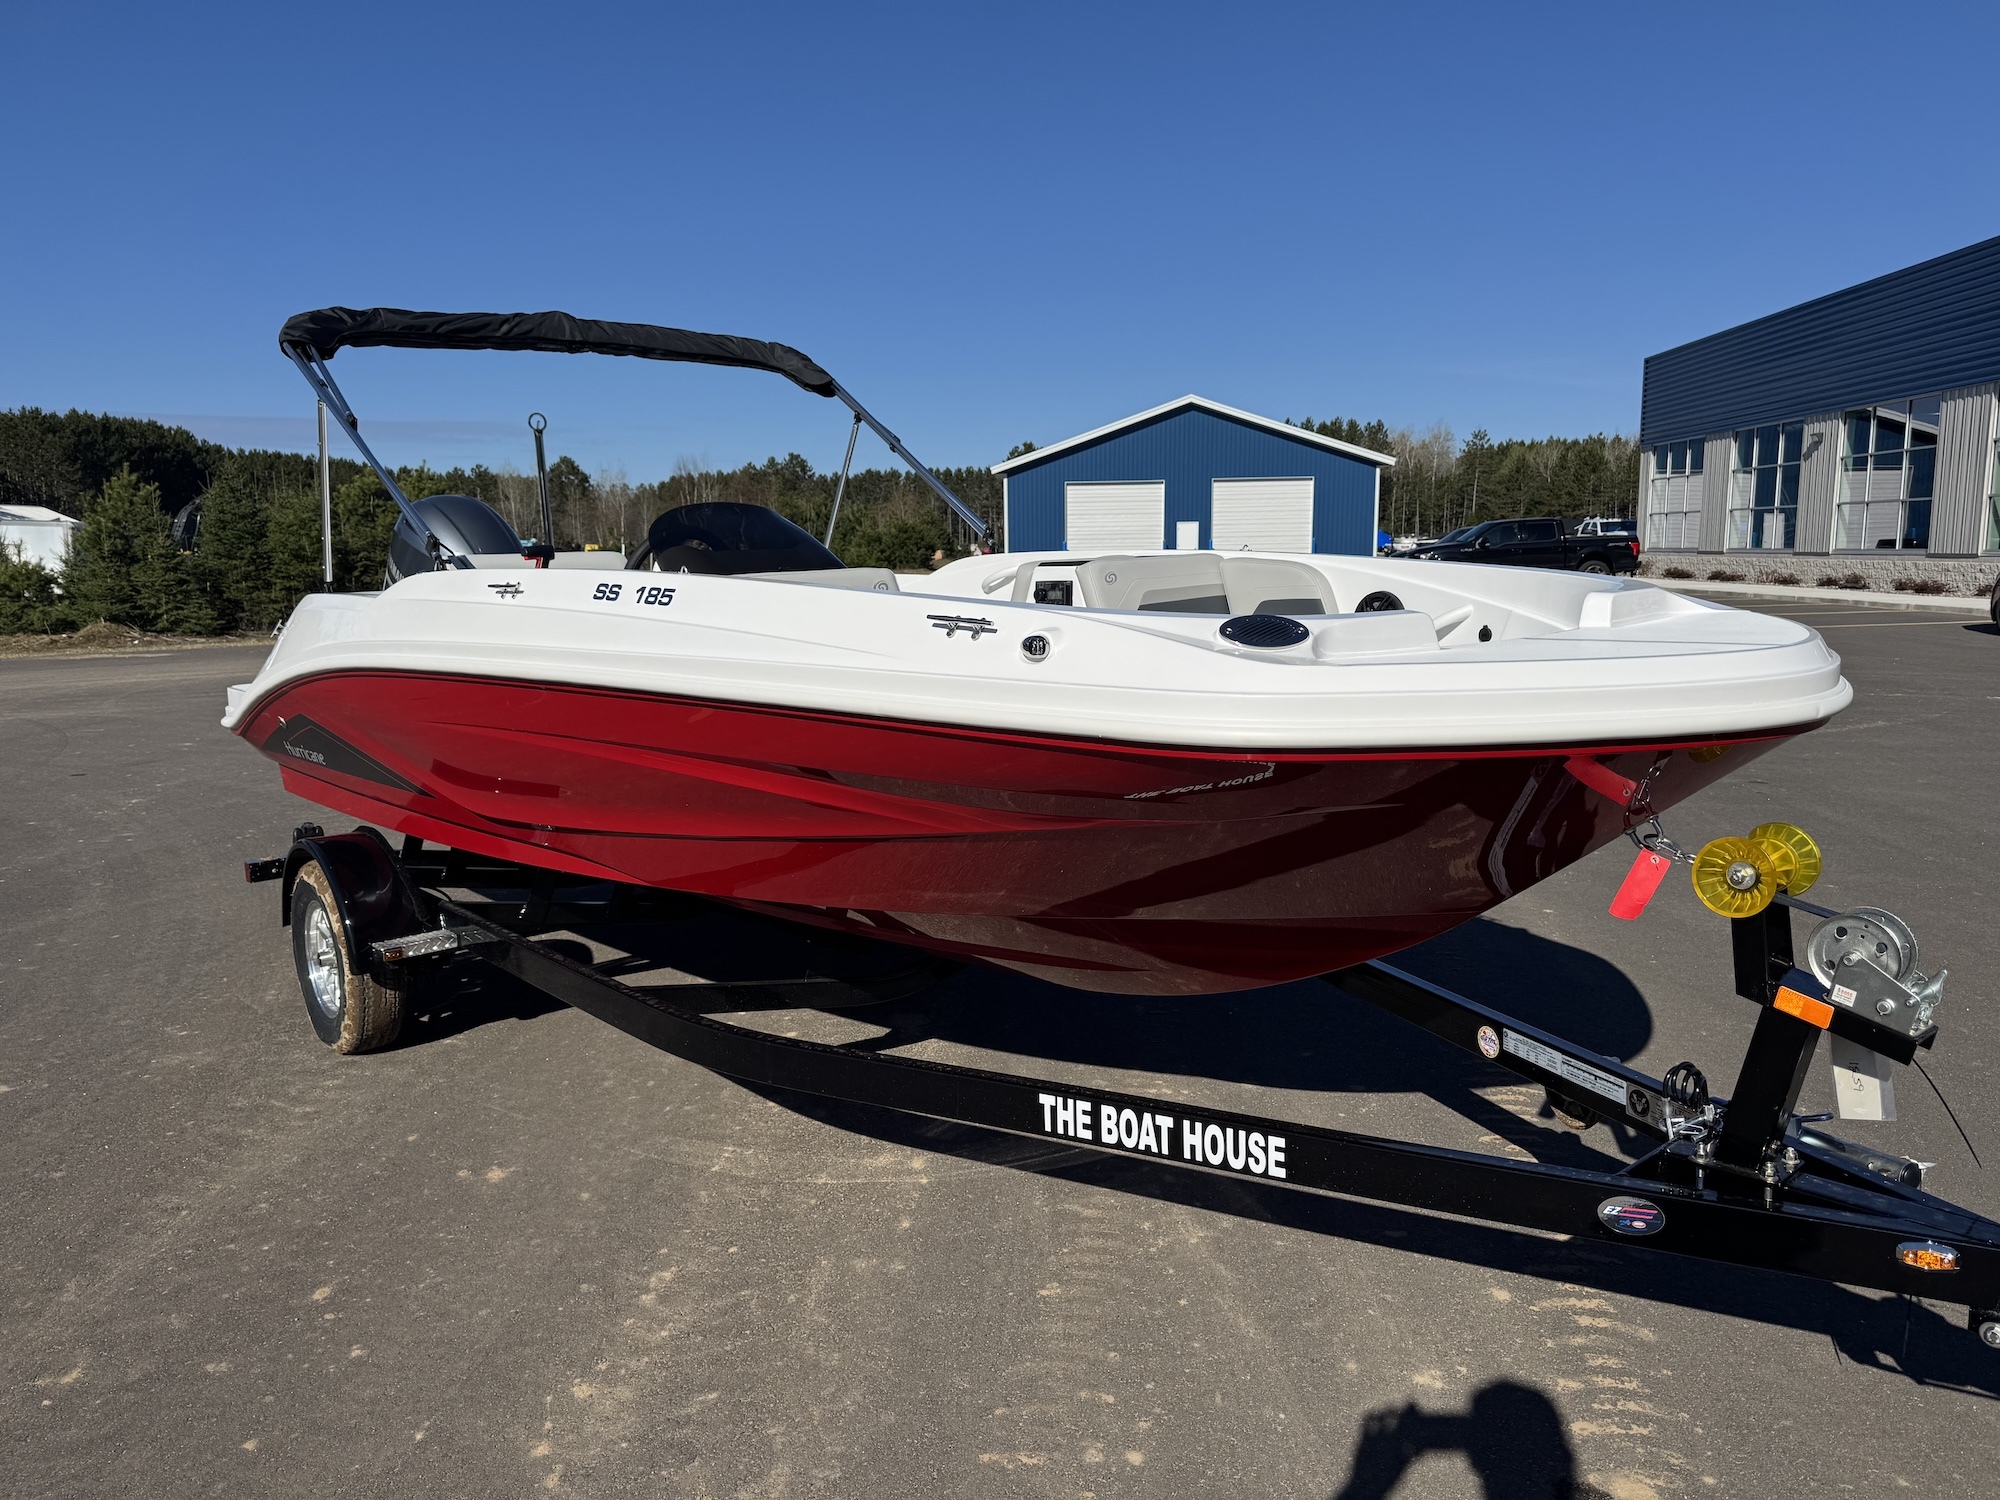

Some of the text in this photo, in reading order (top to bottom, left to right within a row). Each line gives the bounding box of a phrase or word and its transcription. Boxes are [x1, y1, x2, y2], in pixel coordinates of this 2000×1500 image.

[593, 583, 676, 606] SS 185
[283, 740, 326, 765] Hurricane
[1038, 1092, 1286, 1178] THE BOAT HOUSE
[1603, 1205, 1622, 1215] EZ
